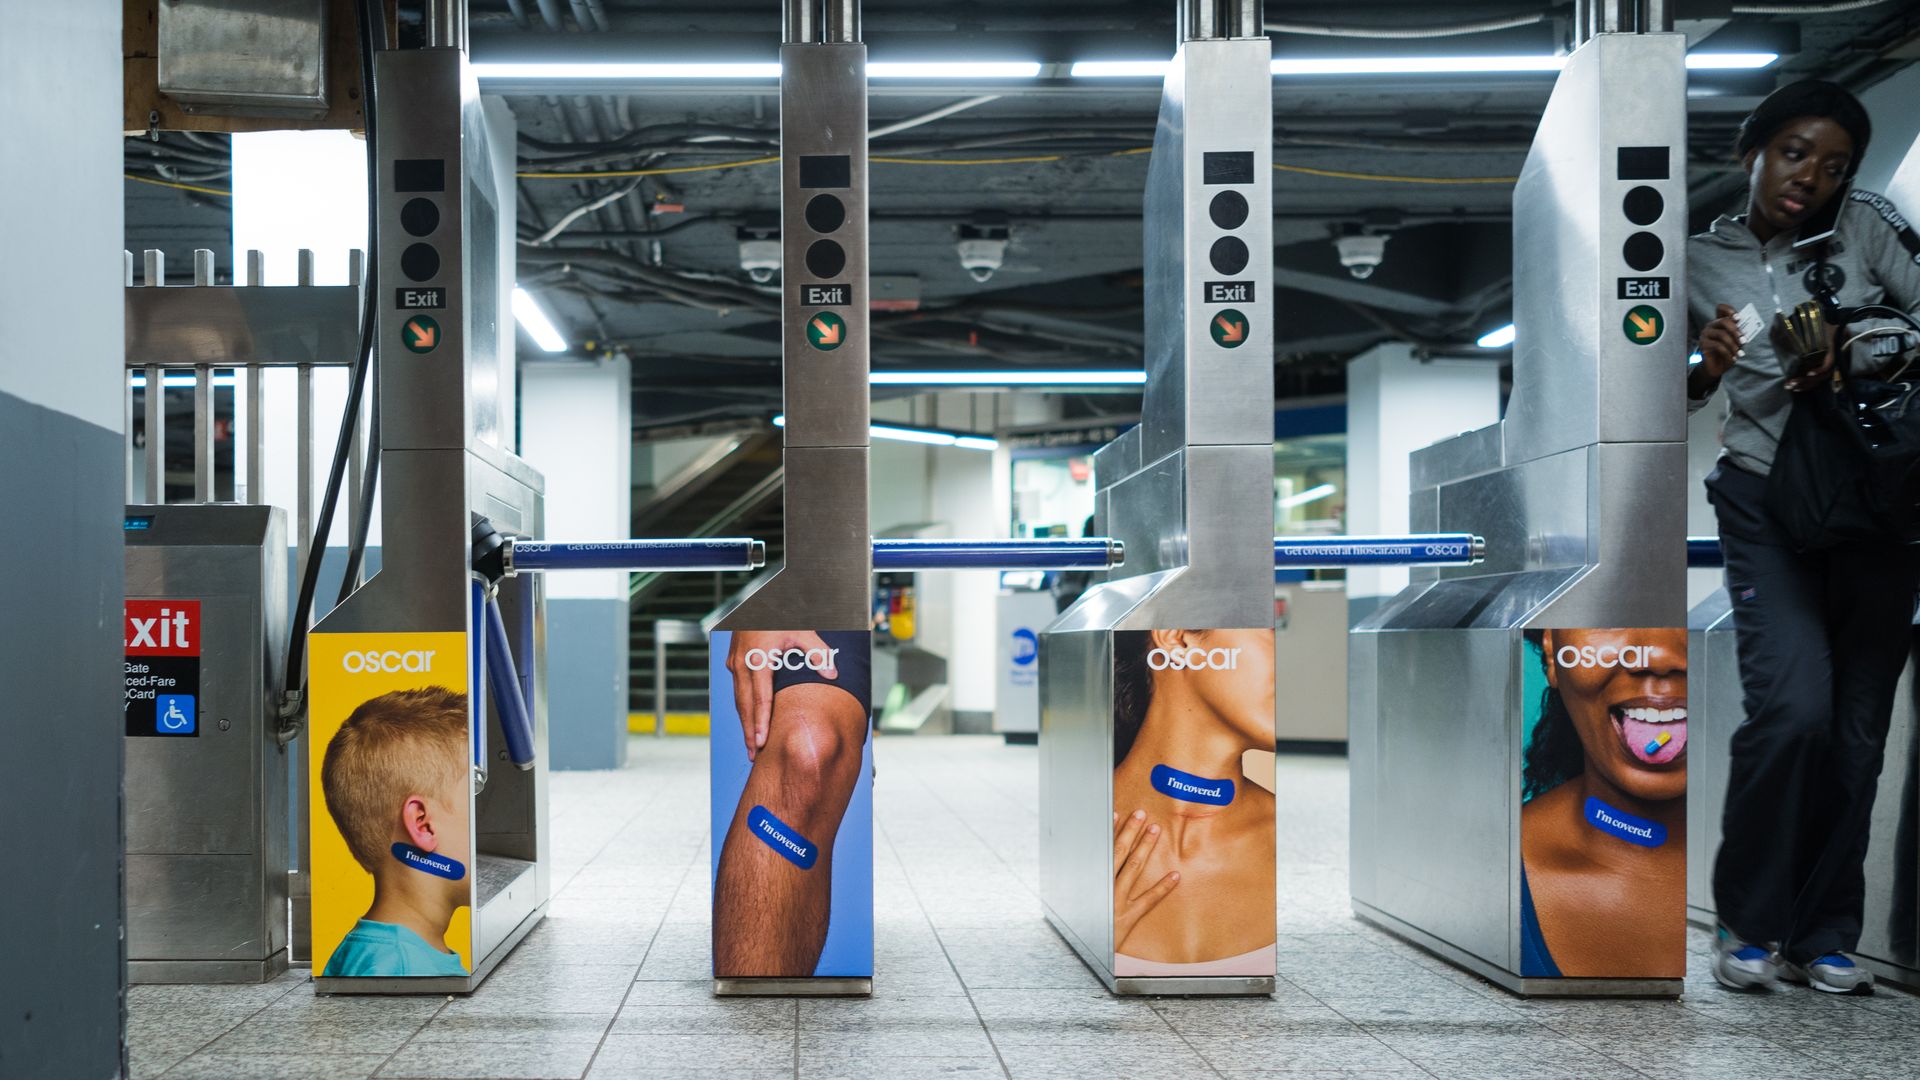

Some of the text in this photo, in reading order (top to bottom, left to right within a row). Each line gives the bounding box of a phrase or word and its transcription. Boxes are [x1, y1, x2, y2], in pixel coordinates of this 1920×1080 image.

[808, 287, 843, 304] Exit
[1211, 285, 1246, 301] Exit
[1625, 280, 1660, 297] Exit
[404, 291, 438, 307] Exit
[515, 543, 551, 552] oscar
[567, 542, 584, 551] Get
[584, 542, 622, 551] covered
[1284, 546, 1302, 556] Get
[1302, 546, 1340, 556] covered
[1341, 546, 1352, 556] at
[1425, 545, 1464, 556] oscar
[124, 608, 190, 649] xit
[342, 650, 436, 673] oscar
[744, 648, 839, 671] oscar
[1146, 647, 1242, 671] oscar
[1556, 645, 1654, 669] oscar
[124, 662, 150, 674] Gate
[124, 675, 176, 687] ced-Fare
[1183, 783, 1222, 798] covered.
[1612, 818, 1652, 839] covered.
[772, 831, 807, 858] covered.
[419, 857, 452, 873] covered.
